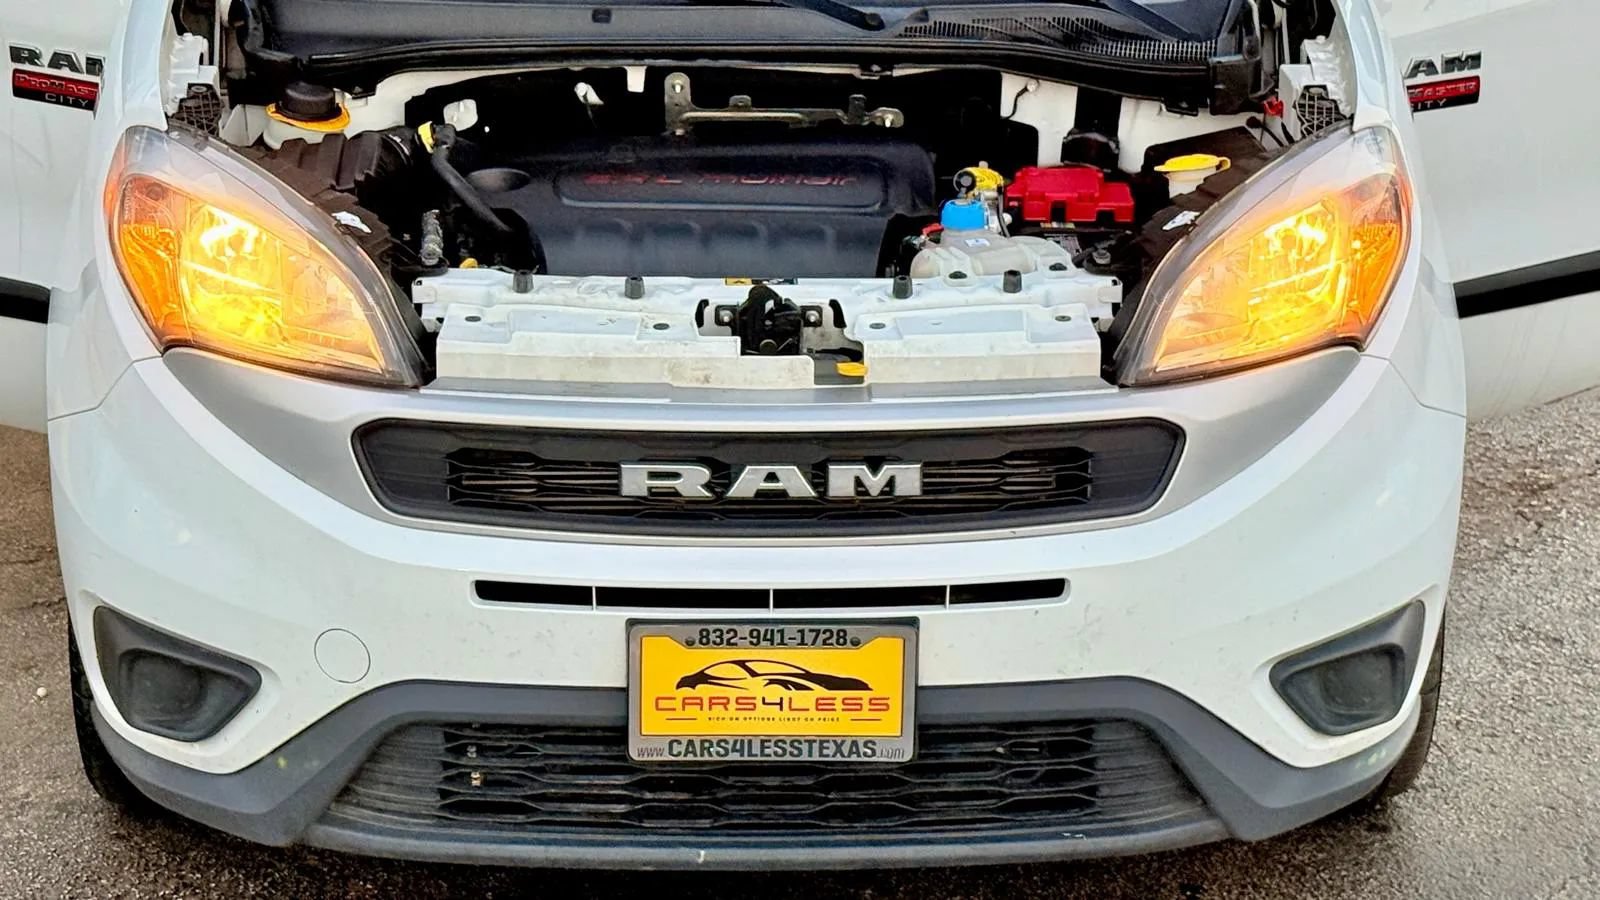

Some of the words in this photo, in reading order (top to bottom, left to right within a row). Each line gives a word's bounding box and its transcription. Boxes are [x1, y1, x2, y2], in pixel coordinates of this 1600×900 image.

[1403, 51, 1482, 79] AM
[14, 73, 98, 96] PROMAST
[44, 92, 89, 107] CITY
[1410, 98, 1447, 111] ITY
[620, 463, 922, 498] RAM
[699, 628, 848, 648] 832-941-1728
[655, 696, 890, 712] CARS4LESS
